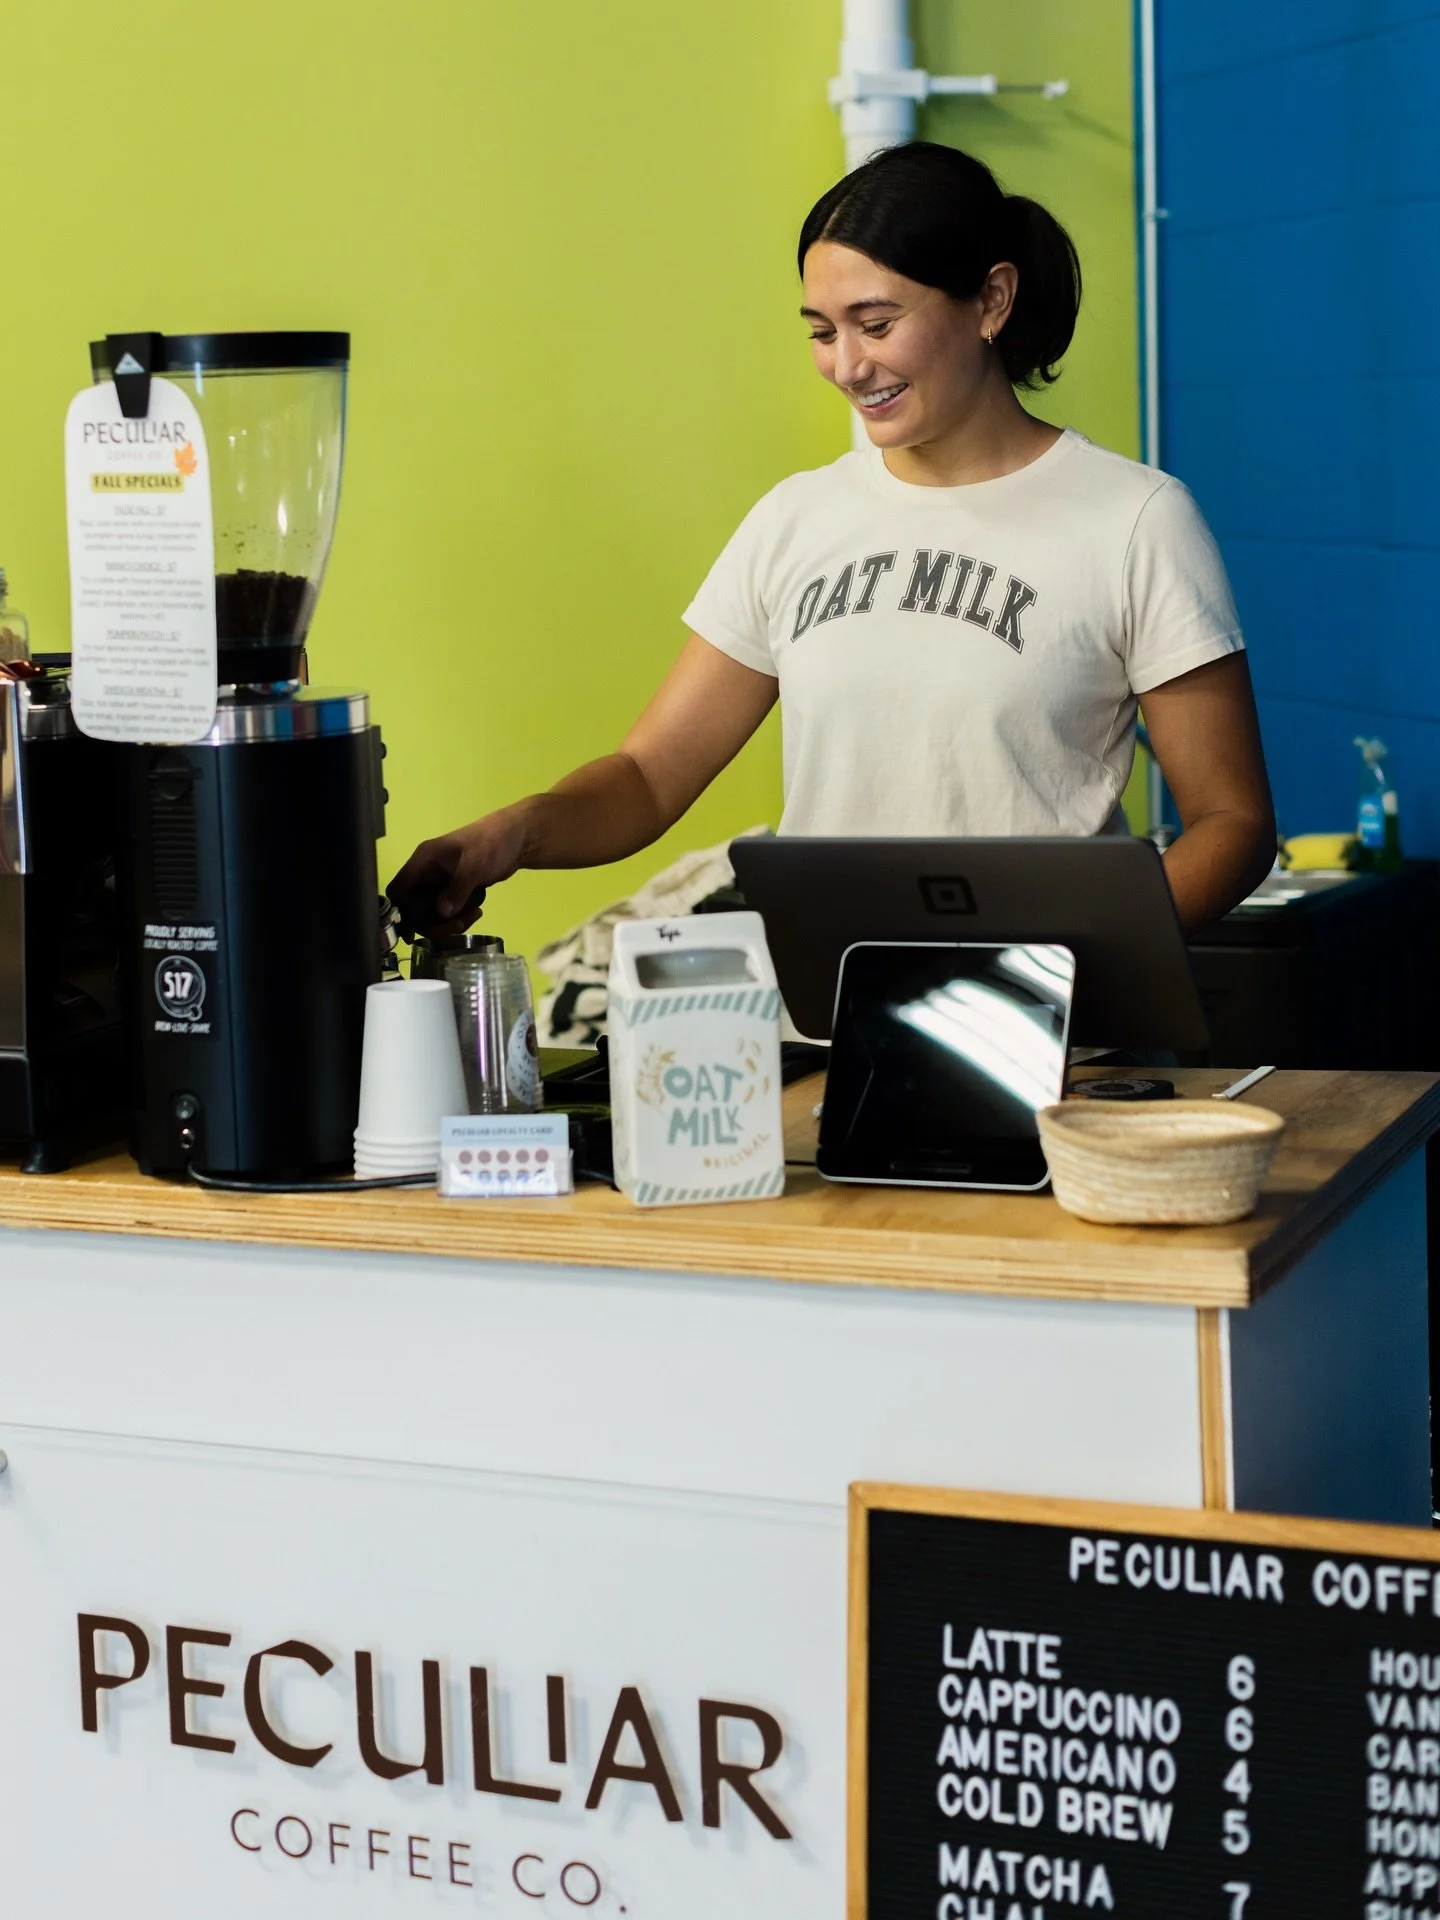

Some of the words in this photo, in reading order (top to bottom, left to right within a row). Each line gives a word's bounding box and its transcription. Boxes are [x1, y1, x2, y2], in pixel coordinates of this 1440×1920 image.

[83, 421, 187, 444] PECULIAR
[94, 475, 121, 488] FALL
[126, 475, 182, 488] SPECIALS
[790, 550, 898, 642] OAT
[897, 548, 1038, 655] MILK
[144, 924, 177, 938] PROUDLY
[178, 926, 216, 939] SERVING
[662, 1062, 745, 1103] OAT
[667, 1106, 743, 1147] MILK
[1069, 1536, 1284, 1602] PECULIAR
[1312, 1561, 1440, 1617] COFF
[942, 1623, 1062, 1680] LATTE
[1227, 1654, 1256, 1701] 6
[1370, 1649, 1440, 1690] HOU
[77, 1612, 793, 1840] PECULIAR
[937, 1672, 1181, 1744] CAPPUCCINO
[1225, 1705, 1254, 1752] 6
[1366, 1691, 1440, 1731] VAN
[936, 1723, 1177, 1795] AMERICANO
[1223, 1758, 1252, 1804] 4
[1366, 1733, 1440, 1774] CAR
[936, 1772, 1044, 1828] COLD
[1056, 1785, 1174, 1851] BREW
[1222, 1808, 1250, 1855] 5
[1367, 1773, 1439, 1817] BAN
[1367, 1815, 1440, 1858] HON
[230, 1807, 474, 1887] COFFEE
[511, 1853, 628, 1913] CO.
[938, 1841, 1114, 1911] MATCHA
[1222, 1881, 1251, 1920] 7
[1365, 1860, 1438, 1900] APP
